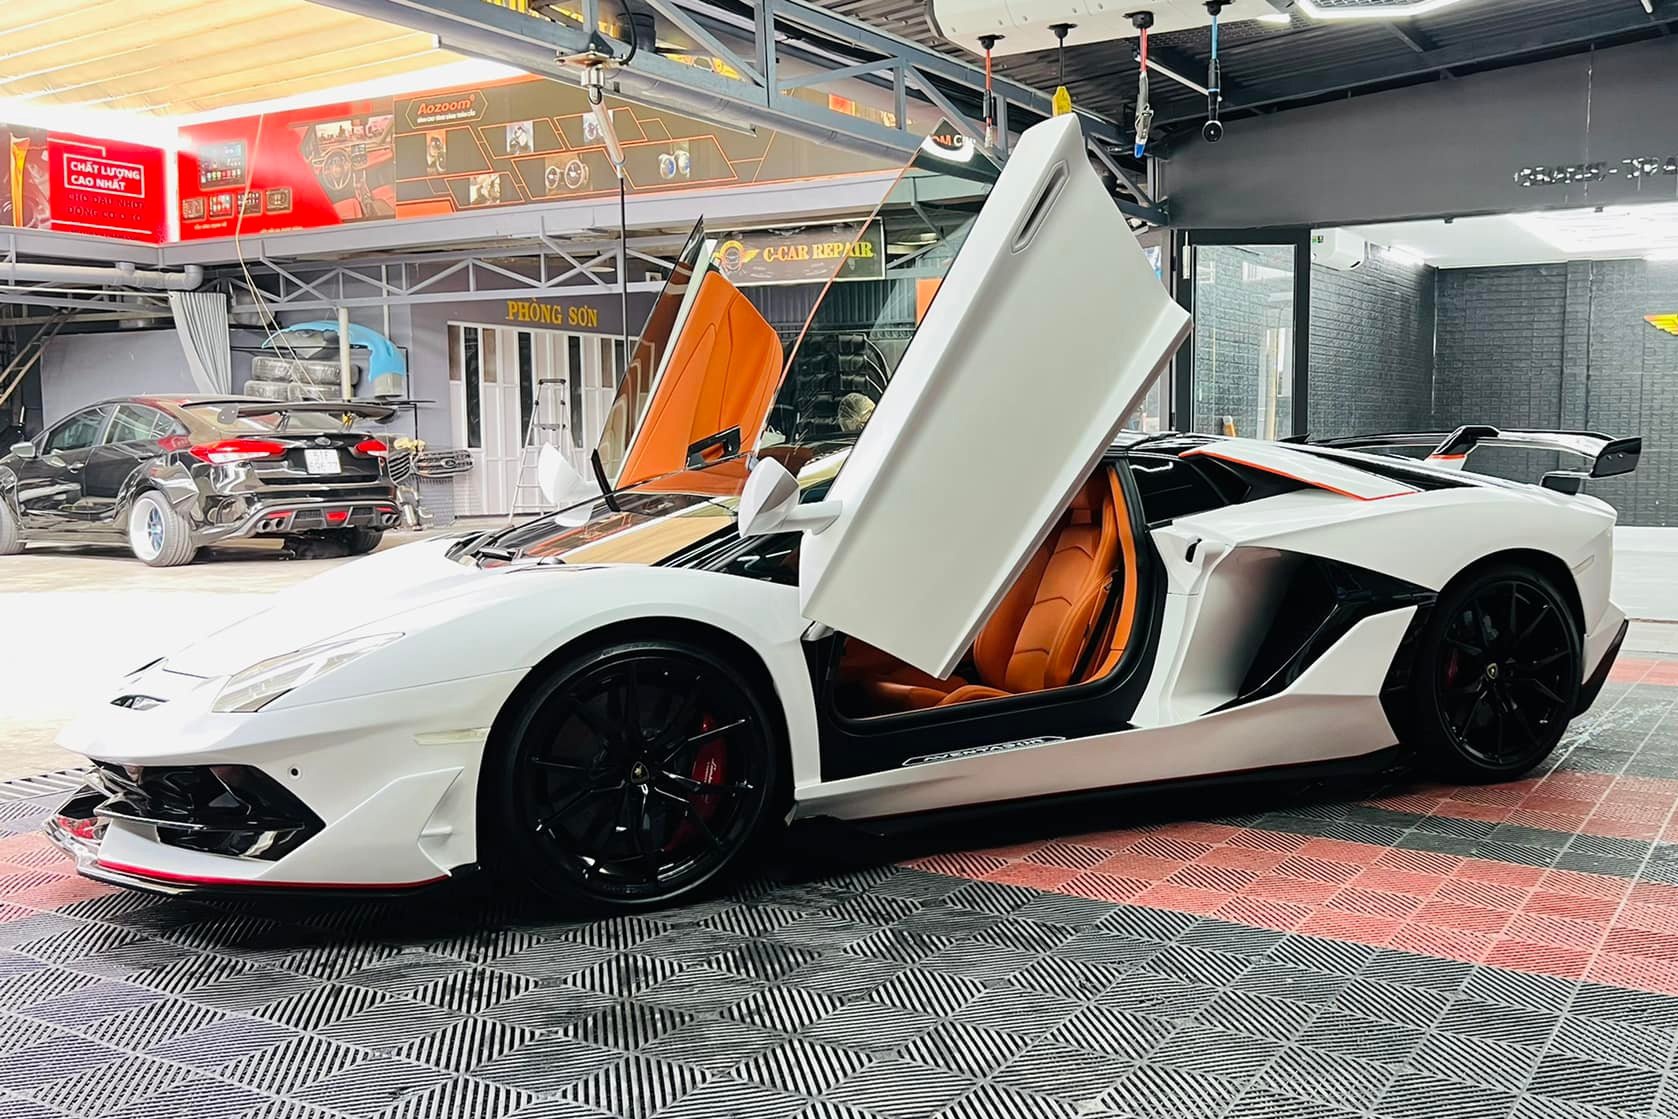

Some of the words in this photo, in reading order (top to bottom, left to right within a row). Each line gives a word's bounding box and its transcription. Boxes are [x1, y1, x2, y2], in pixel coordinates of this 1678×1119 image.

[417, 98, 473, 115] Aozoom
[70, 161, 99, 175] CHẤT
[101, 166, 141, 180] LƯỢNG
[71, 174, 94, 187] CAO
[95, 178, 126, 191] NHẤT
[762, 245, 810, 263] C-CAR
[812, 241, 874, 259] REPAIR
[505, 297, 563, 325] PHÒNG
[568, 305, 598, 328] SƠN
